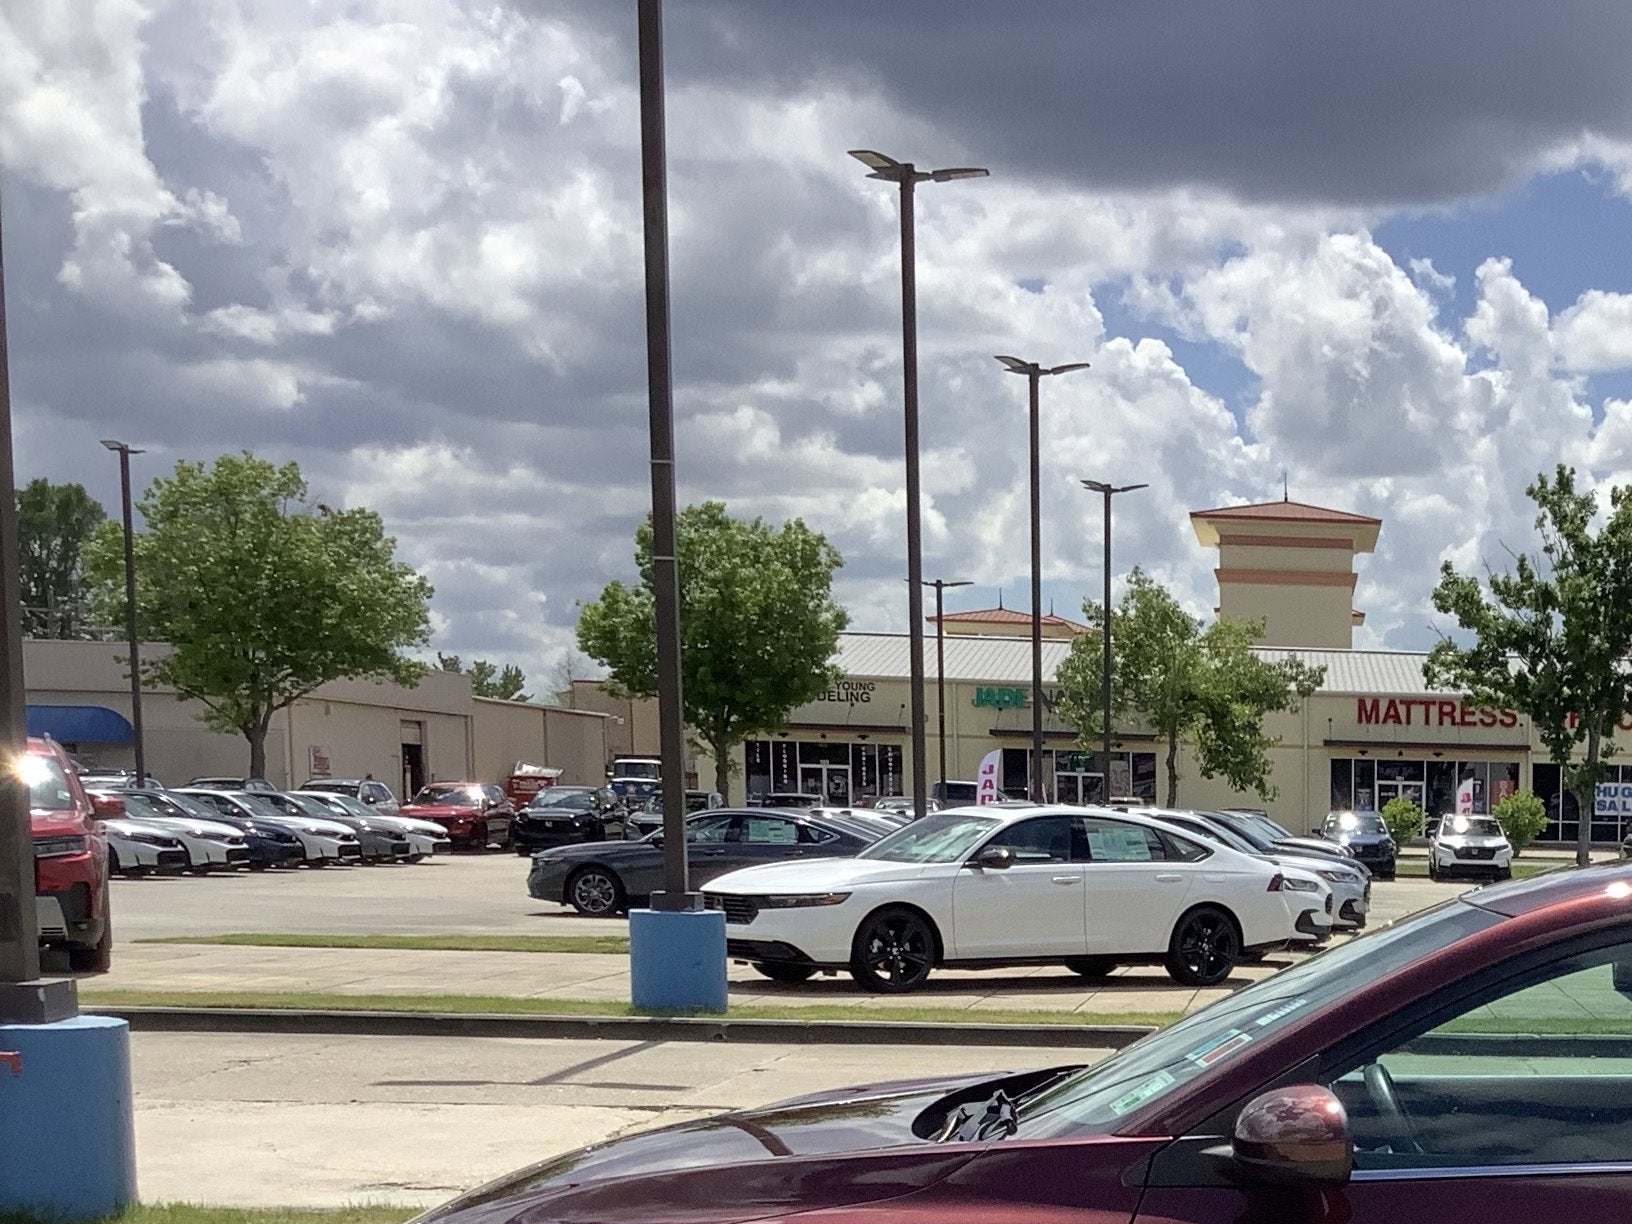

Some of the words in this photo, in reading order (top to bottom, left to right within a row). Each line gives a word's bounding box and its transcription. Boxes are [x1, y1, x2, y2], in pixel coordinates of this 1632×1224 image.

[835, 681, 875, 692] YOUNG
[817, 690, 871, 703] DELING
[1356, 698, 1518, 728] MATTRESS
